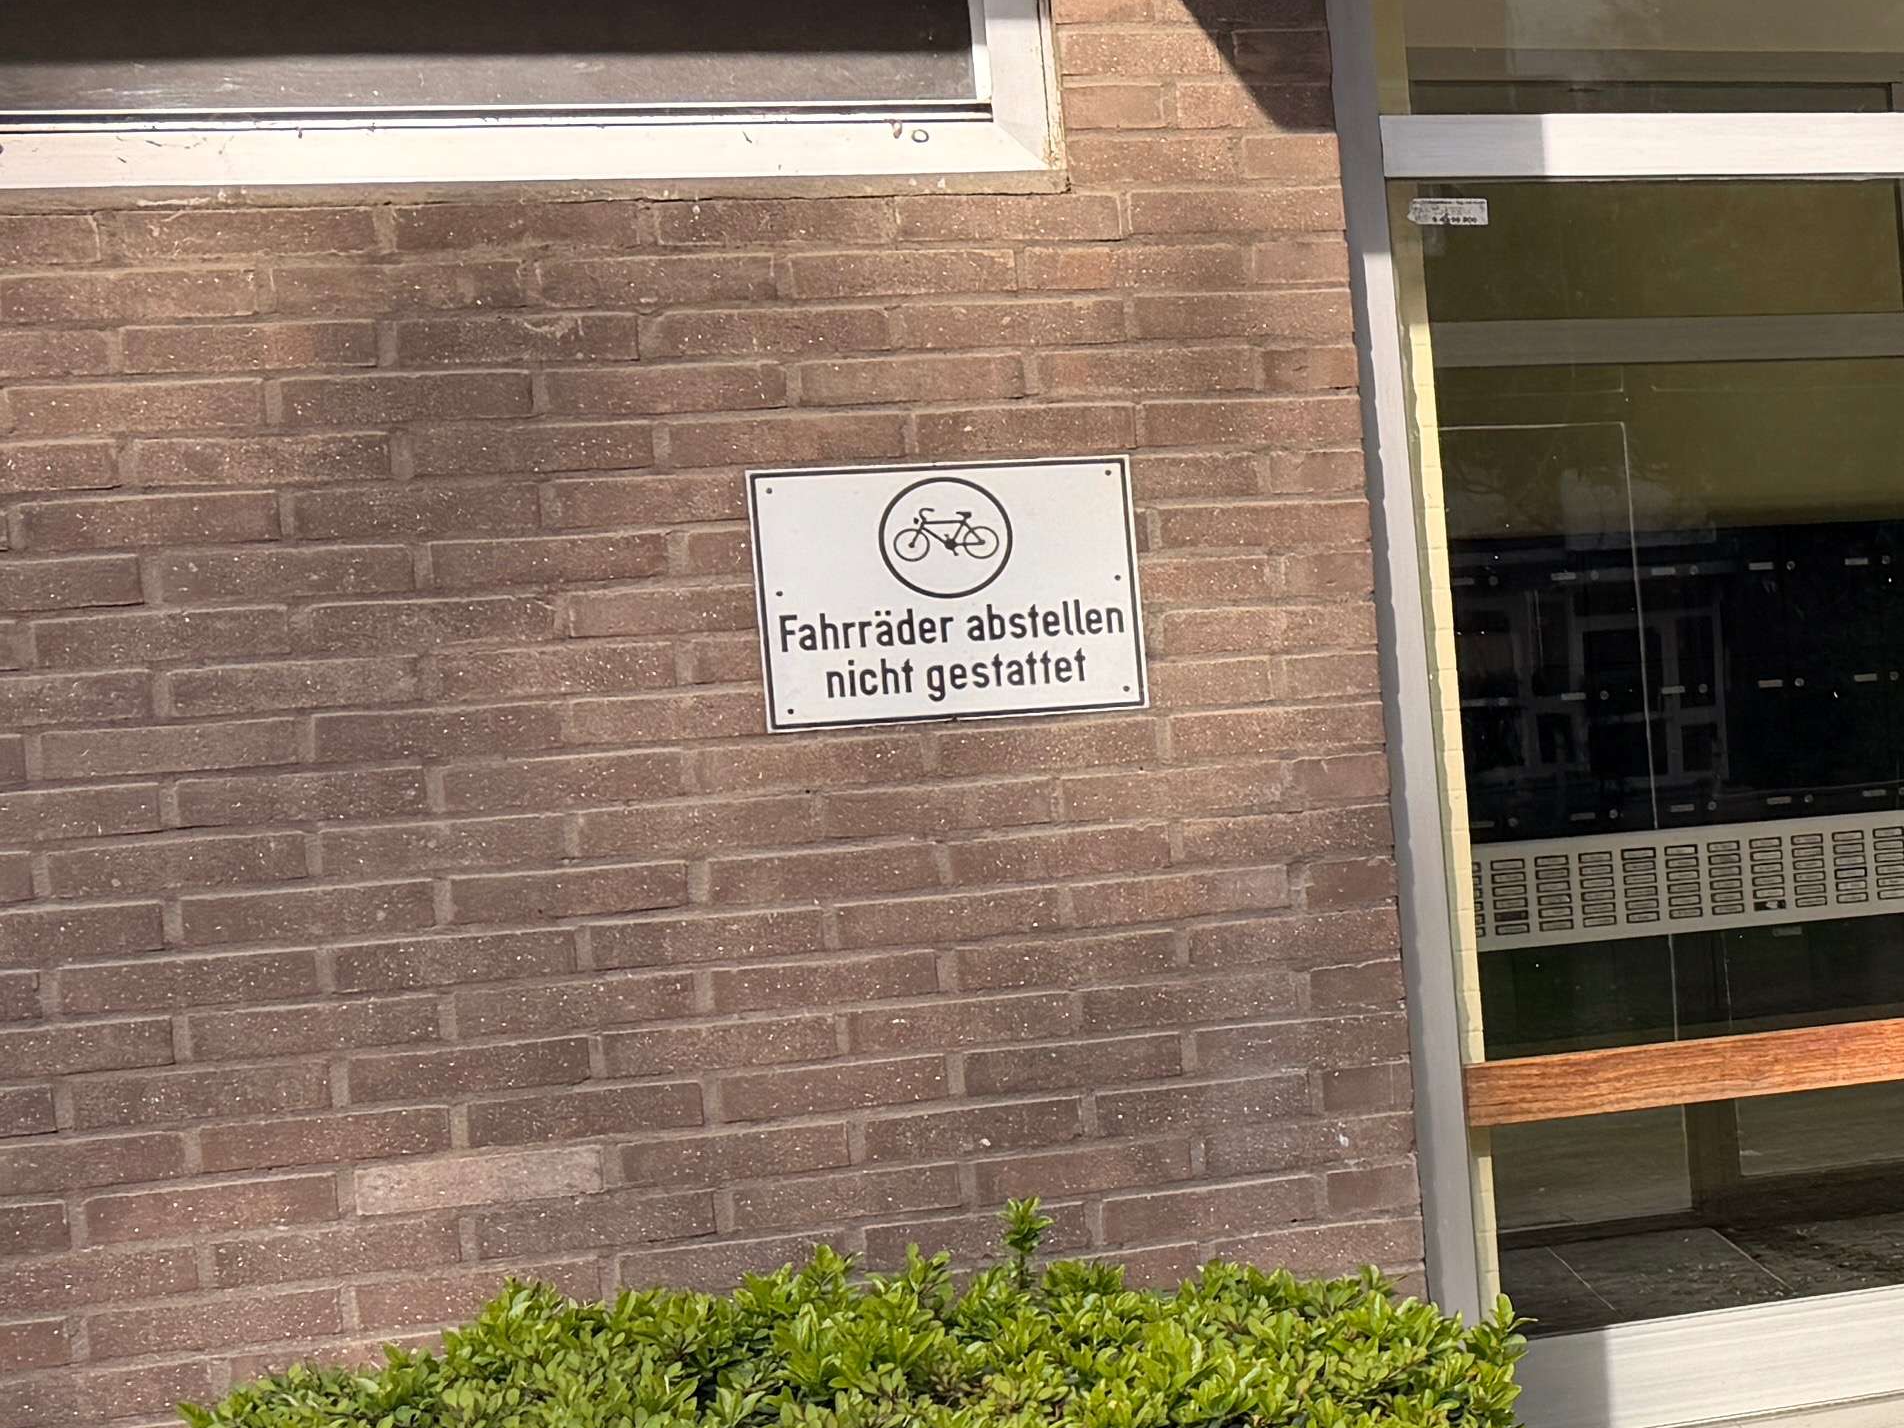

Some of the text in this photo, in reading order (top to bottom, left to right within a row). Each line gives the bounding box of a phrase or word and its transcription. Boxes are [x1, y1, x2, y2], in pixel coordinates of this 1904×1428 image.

[779, 599, 1125, 653] Fahrräder abstellen
[826, 647, 1086, 703] nicht gestattet
